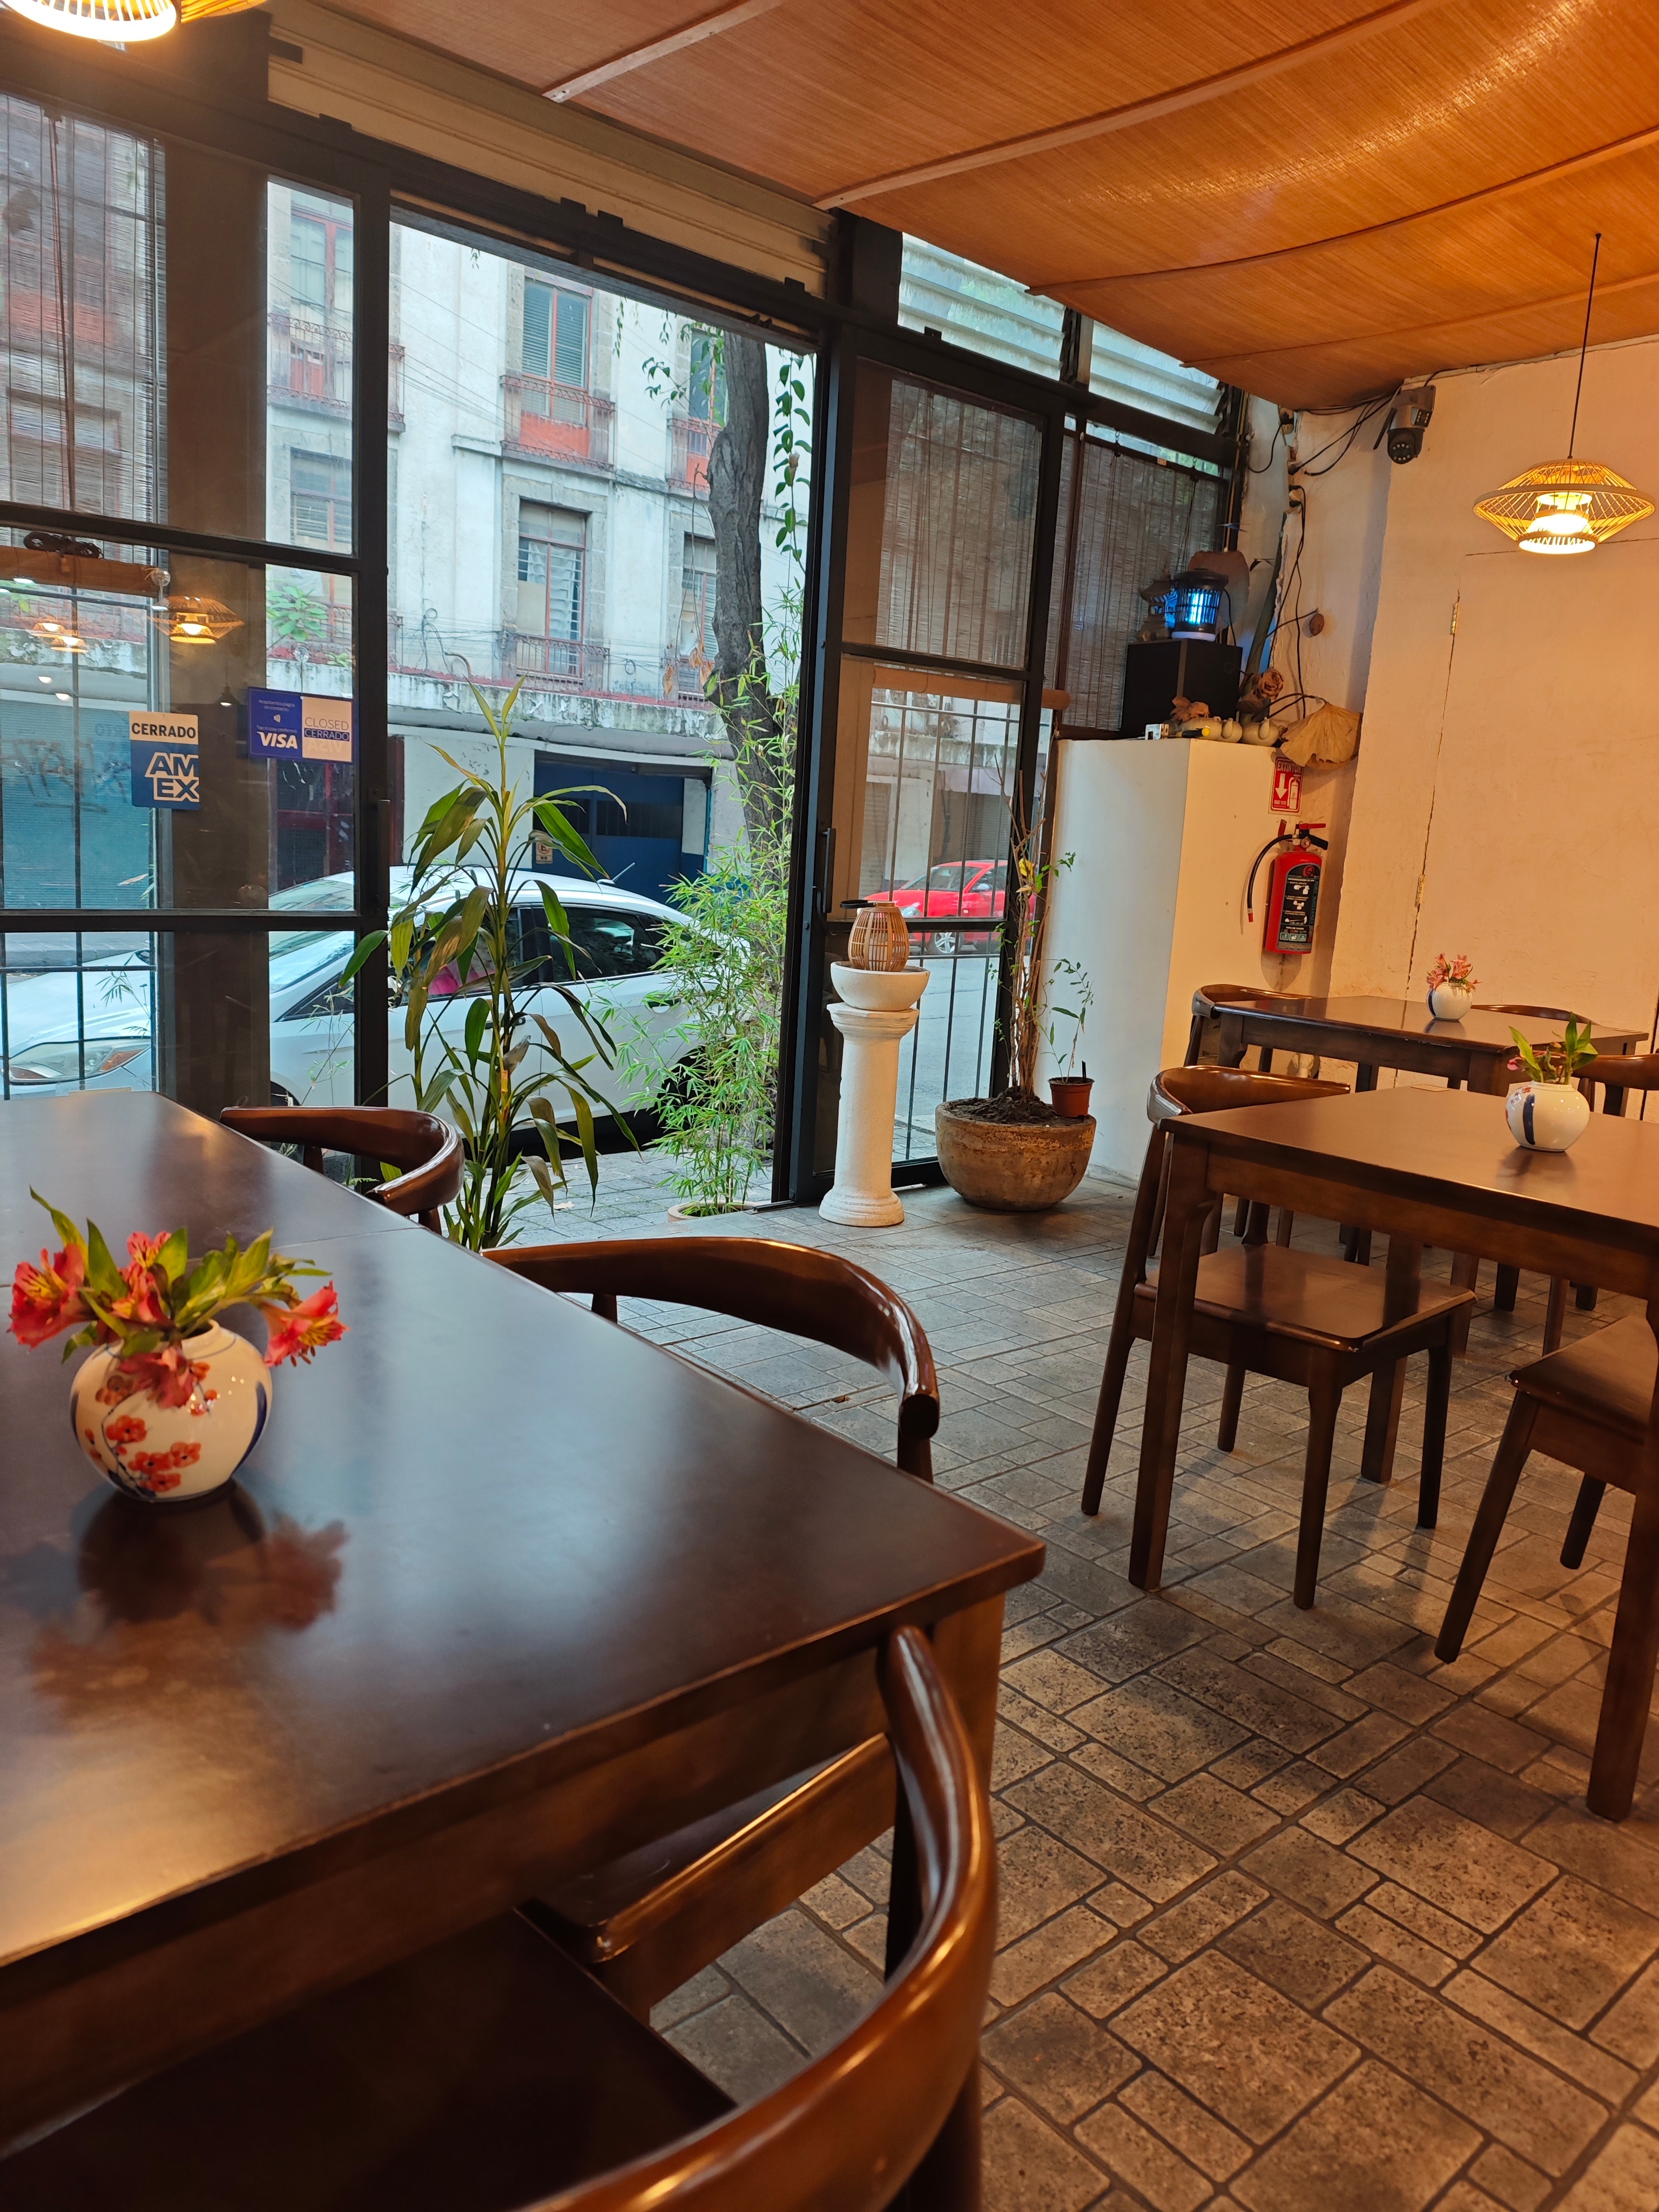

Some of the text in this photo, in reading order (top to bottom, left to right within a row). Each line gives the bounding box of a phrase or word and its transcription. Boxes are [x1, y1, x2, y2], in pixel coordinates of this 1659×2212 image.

[131, 723, 196, 739] CERRADO
[305, 717, 349, 731] CLOSED
[257, 731, 298, 750] VISA
[305, 729, 349, 741] CERRADO
[1277, 761, 1302, 774] EXTINTOR
